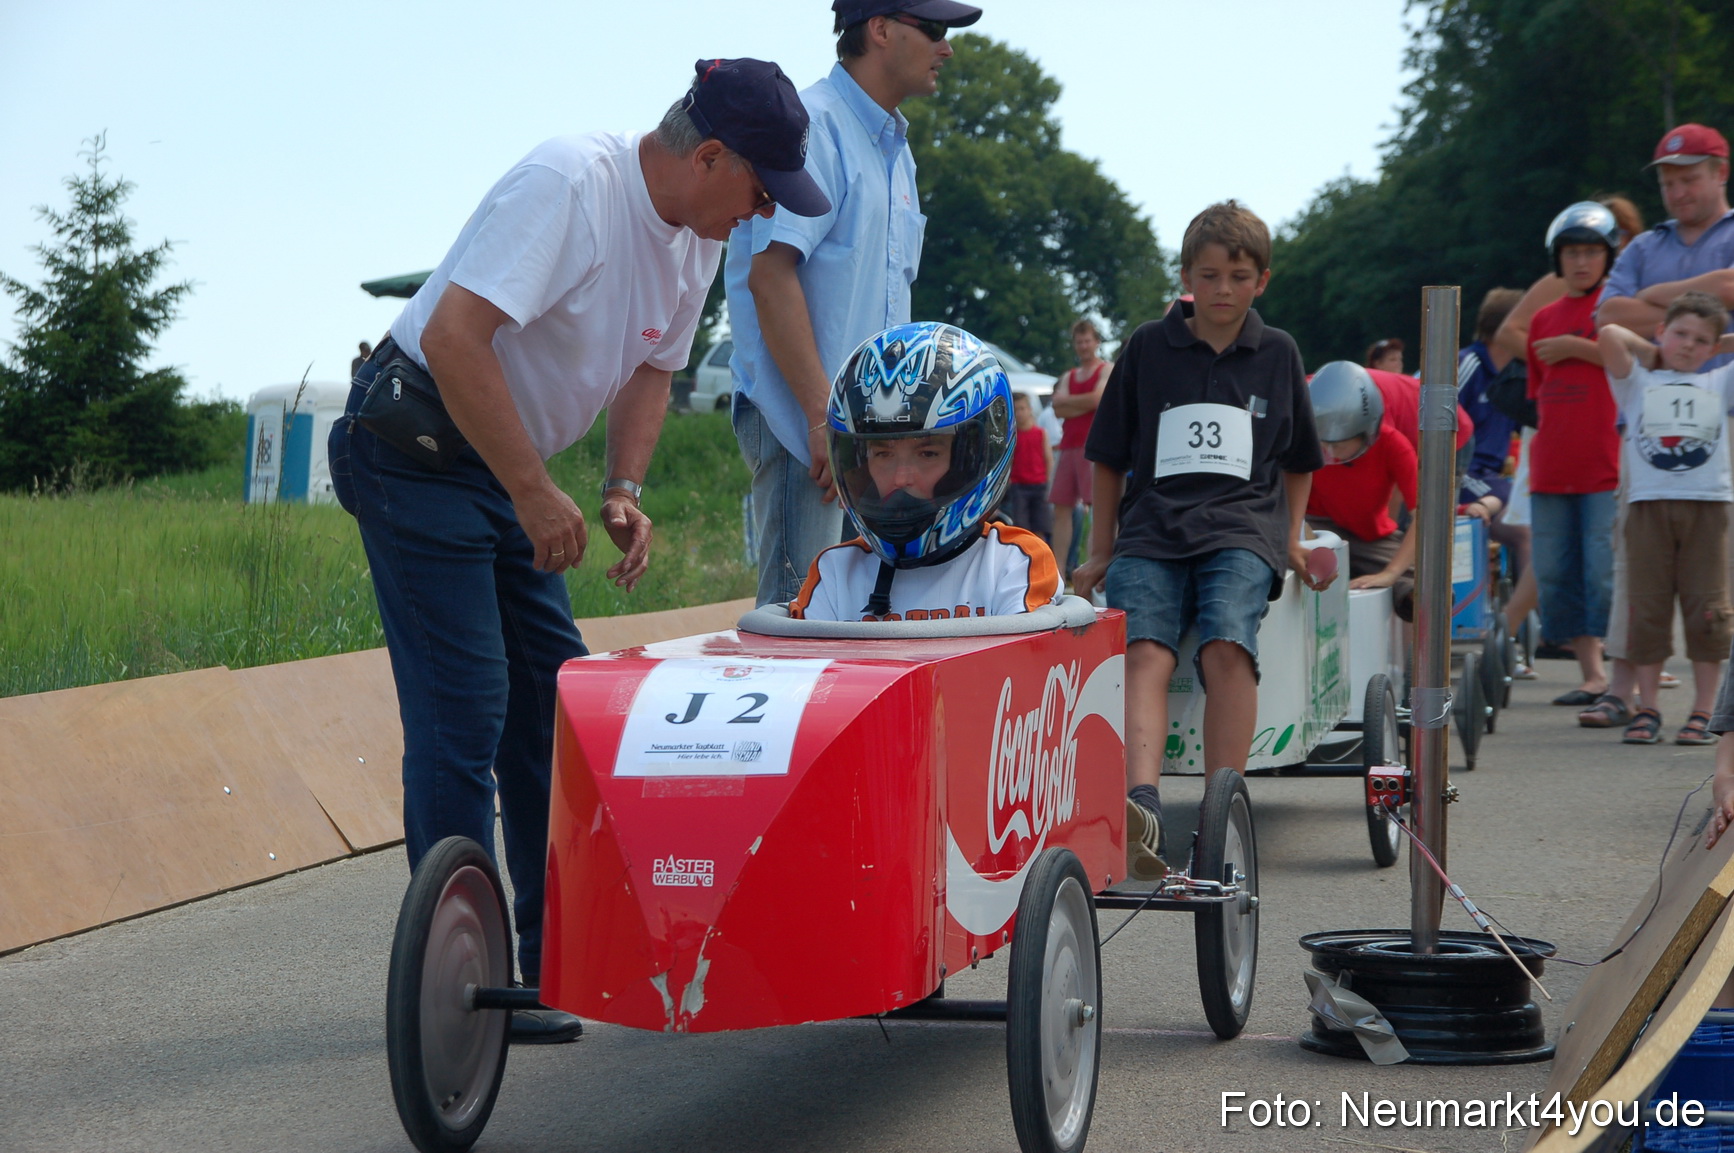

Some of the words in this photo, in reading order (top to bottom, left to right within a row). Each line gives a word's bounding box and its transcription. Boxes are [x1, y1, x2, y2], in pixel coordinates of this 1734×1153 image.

[1670, 398, 1695, 419] 11
[1188, 421, 1222, 449] 33
[665, 692, 715, 724] J
[726, 692, 770, 724] 2
[650, 743, 694, 751] Neumarkter
[695, 742, 725, 751] Tagblatt
[653, 854, 715, 873] RASTER
[654, 874, 713, 885] WERBUNG
